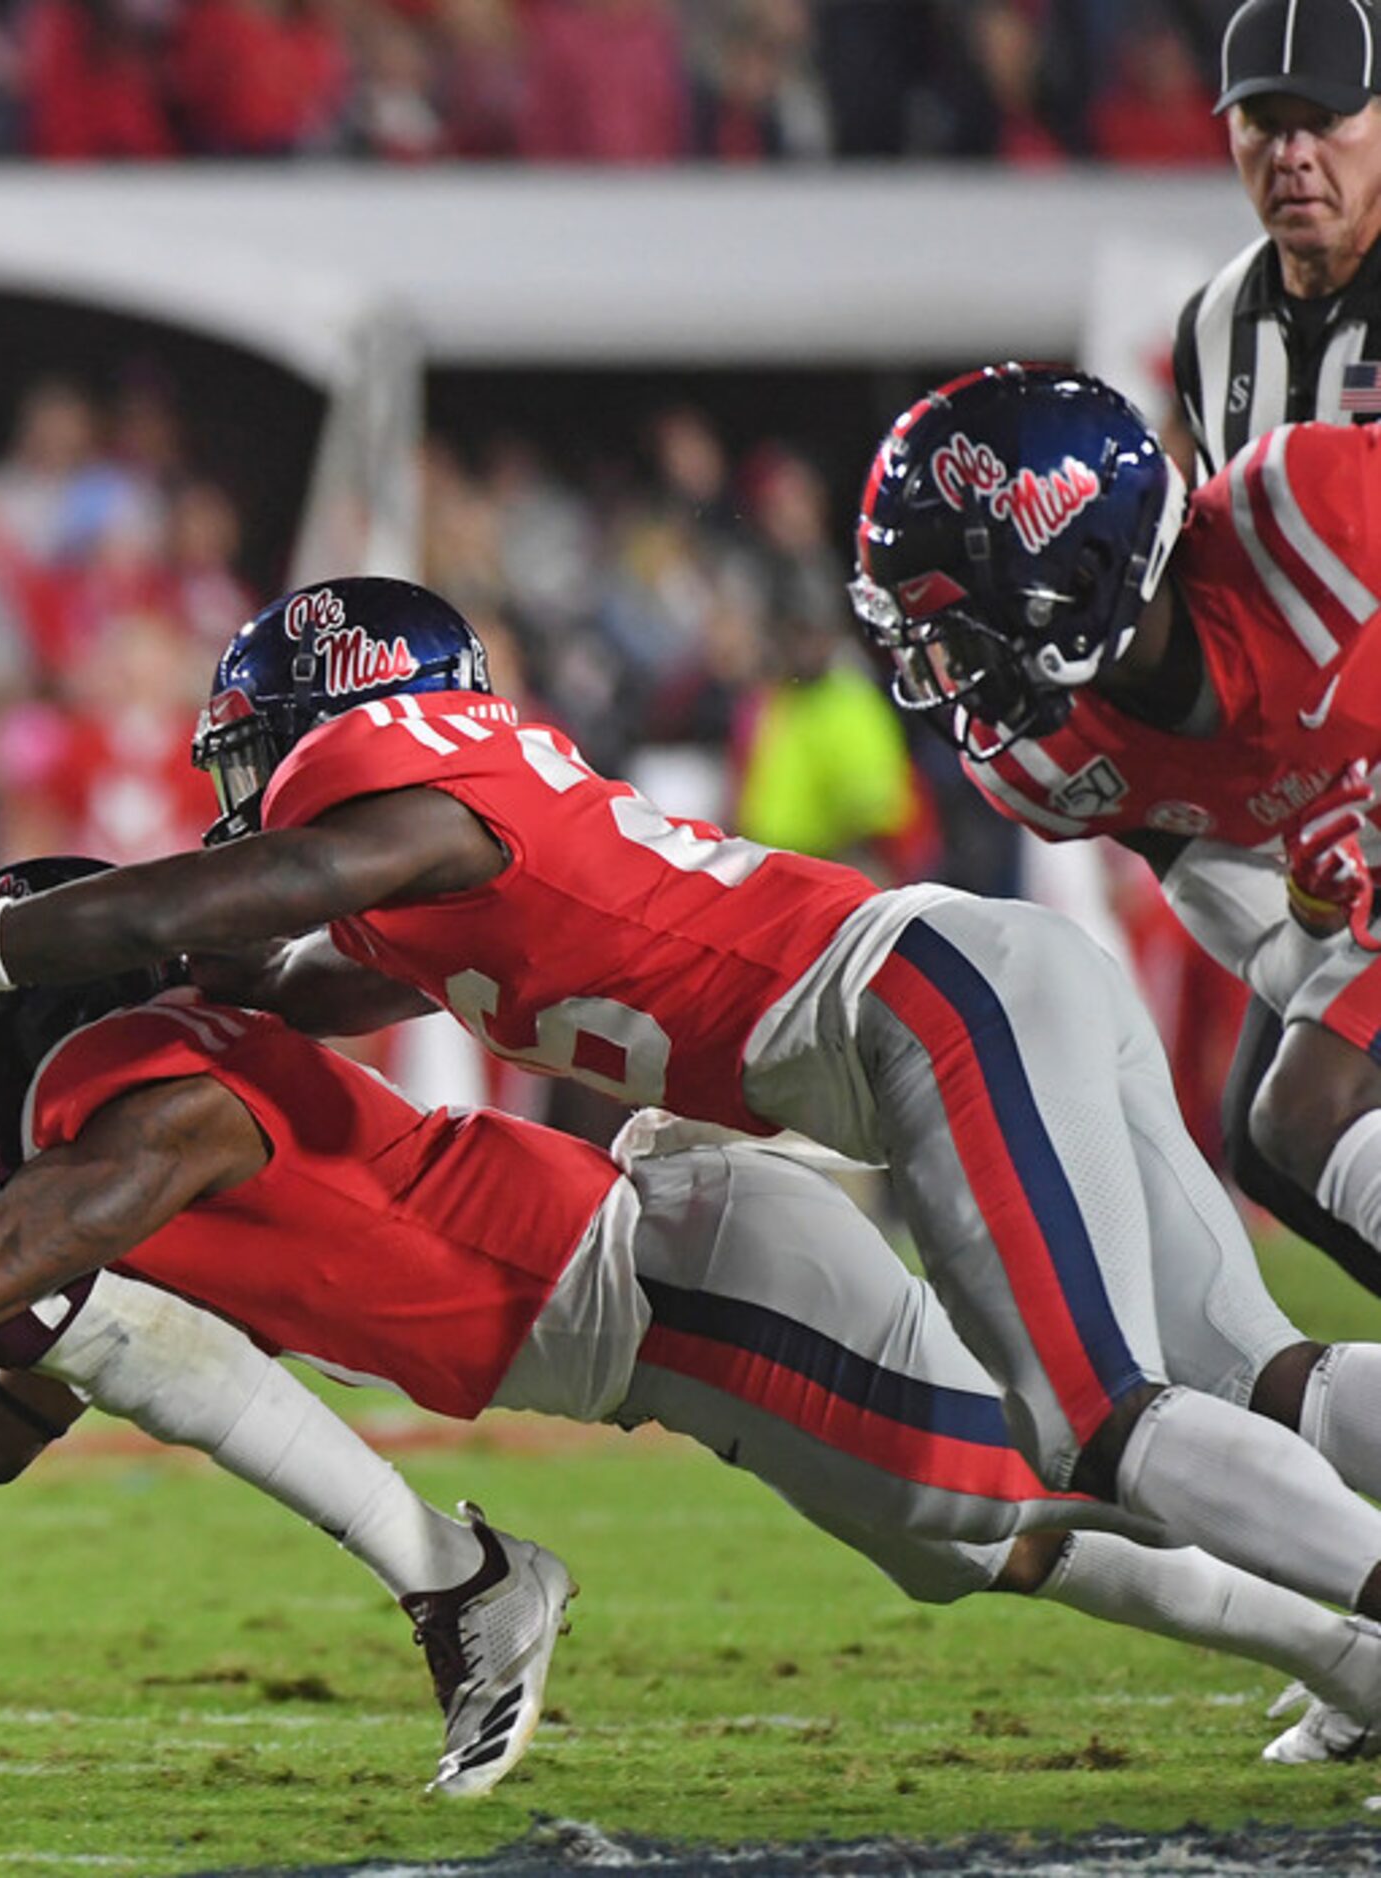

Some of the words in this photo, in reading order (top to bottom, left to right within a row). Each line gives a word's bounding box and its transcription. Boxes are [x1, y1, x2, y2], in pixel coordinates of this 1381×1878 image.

[931, 432, 1006, 512] Ole
[990, 456, 1099, 554] Miss
[285, 588, 346, 641] Ole
[315, 626, 421, 697] Miss
